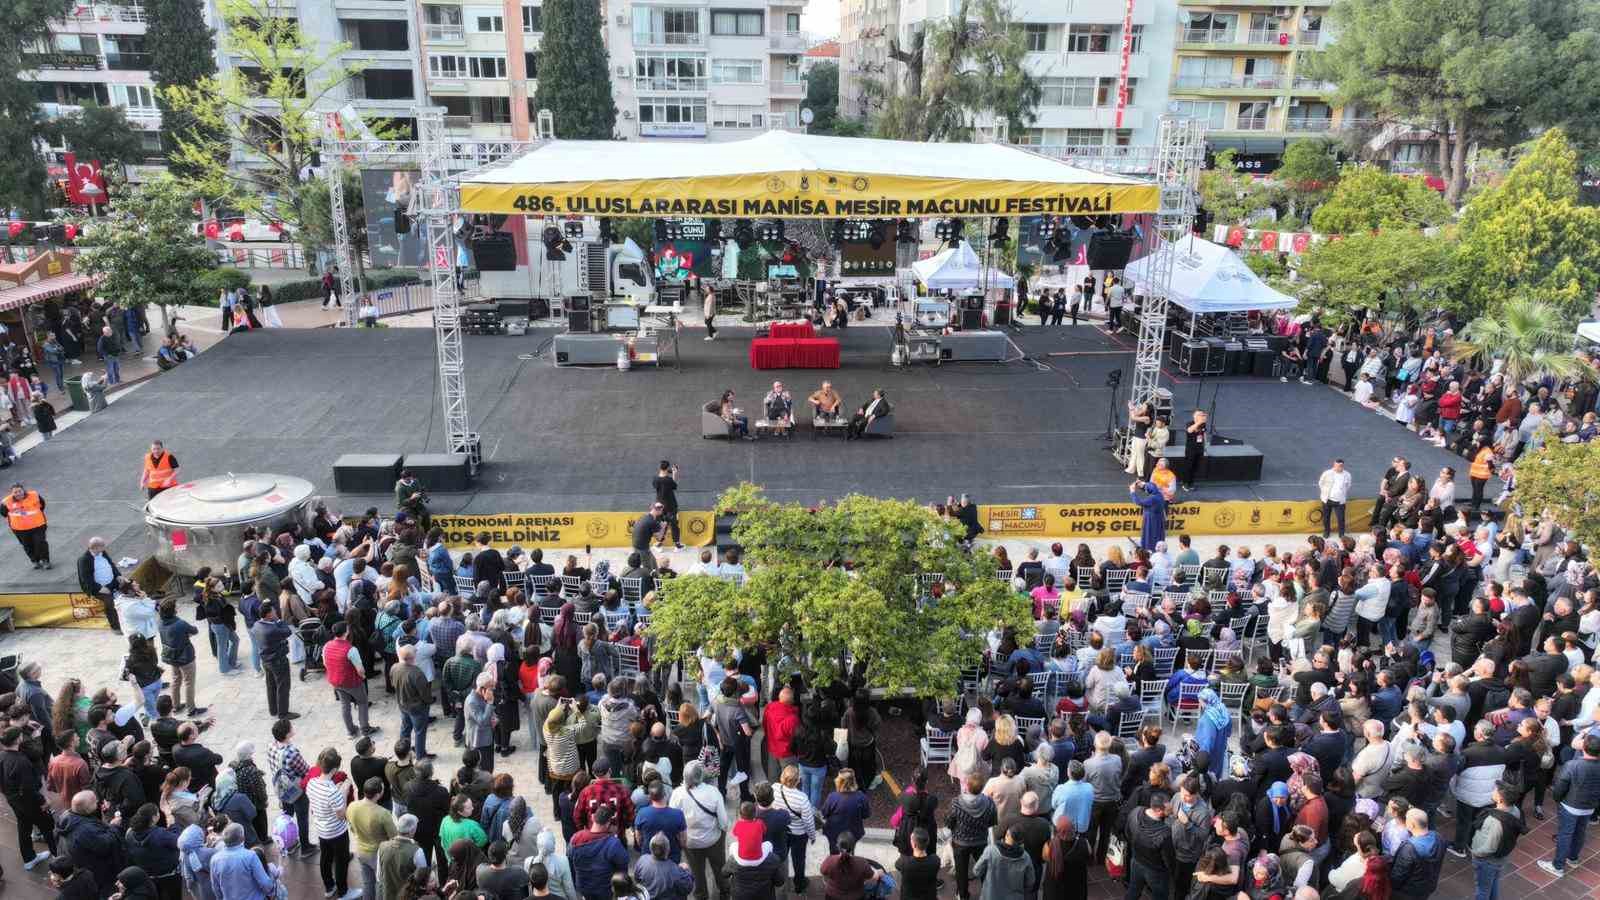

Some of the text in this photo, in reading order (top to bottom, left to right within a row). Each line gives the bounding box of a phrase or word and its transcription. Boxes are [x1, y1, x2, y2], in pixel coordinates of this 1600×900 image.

[513, 192, 1112, 215] 486. ULUSLARARASI MANİSA MESİR MACUNU FESTİVALİ
[431, 515, 575, 528] ASTRONOMİ ARENASI
[1071, 520, 1106, 534] HOŞ
